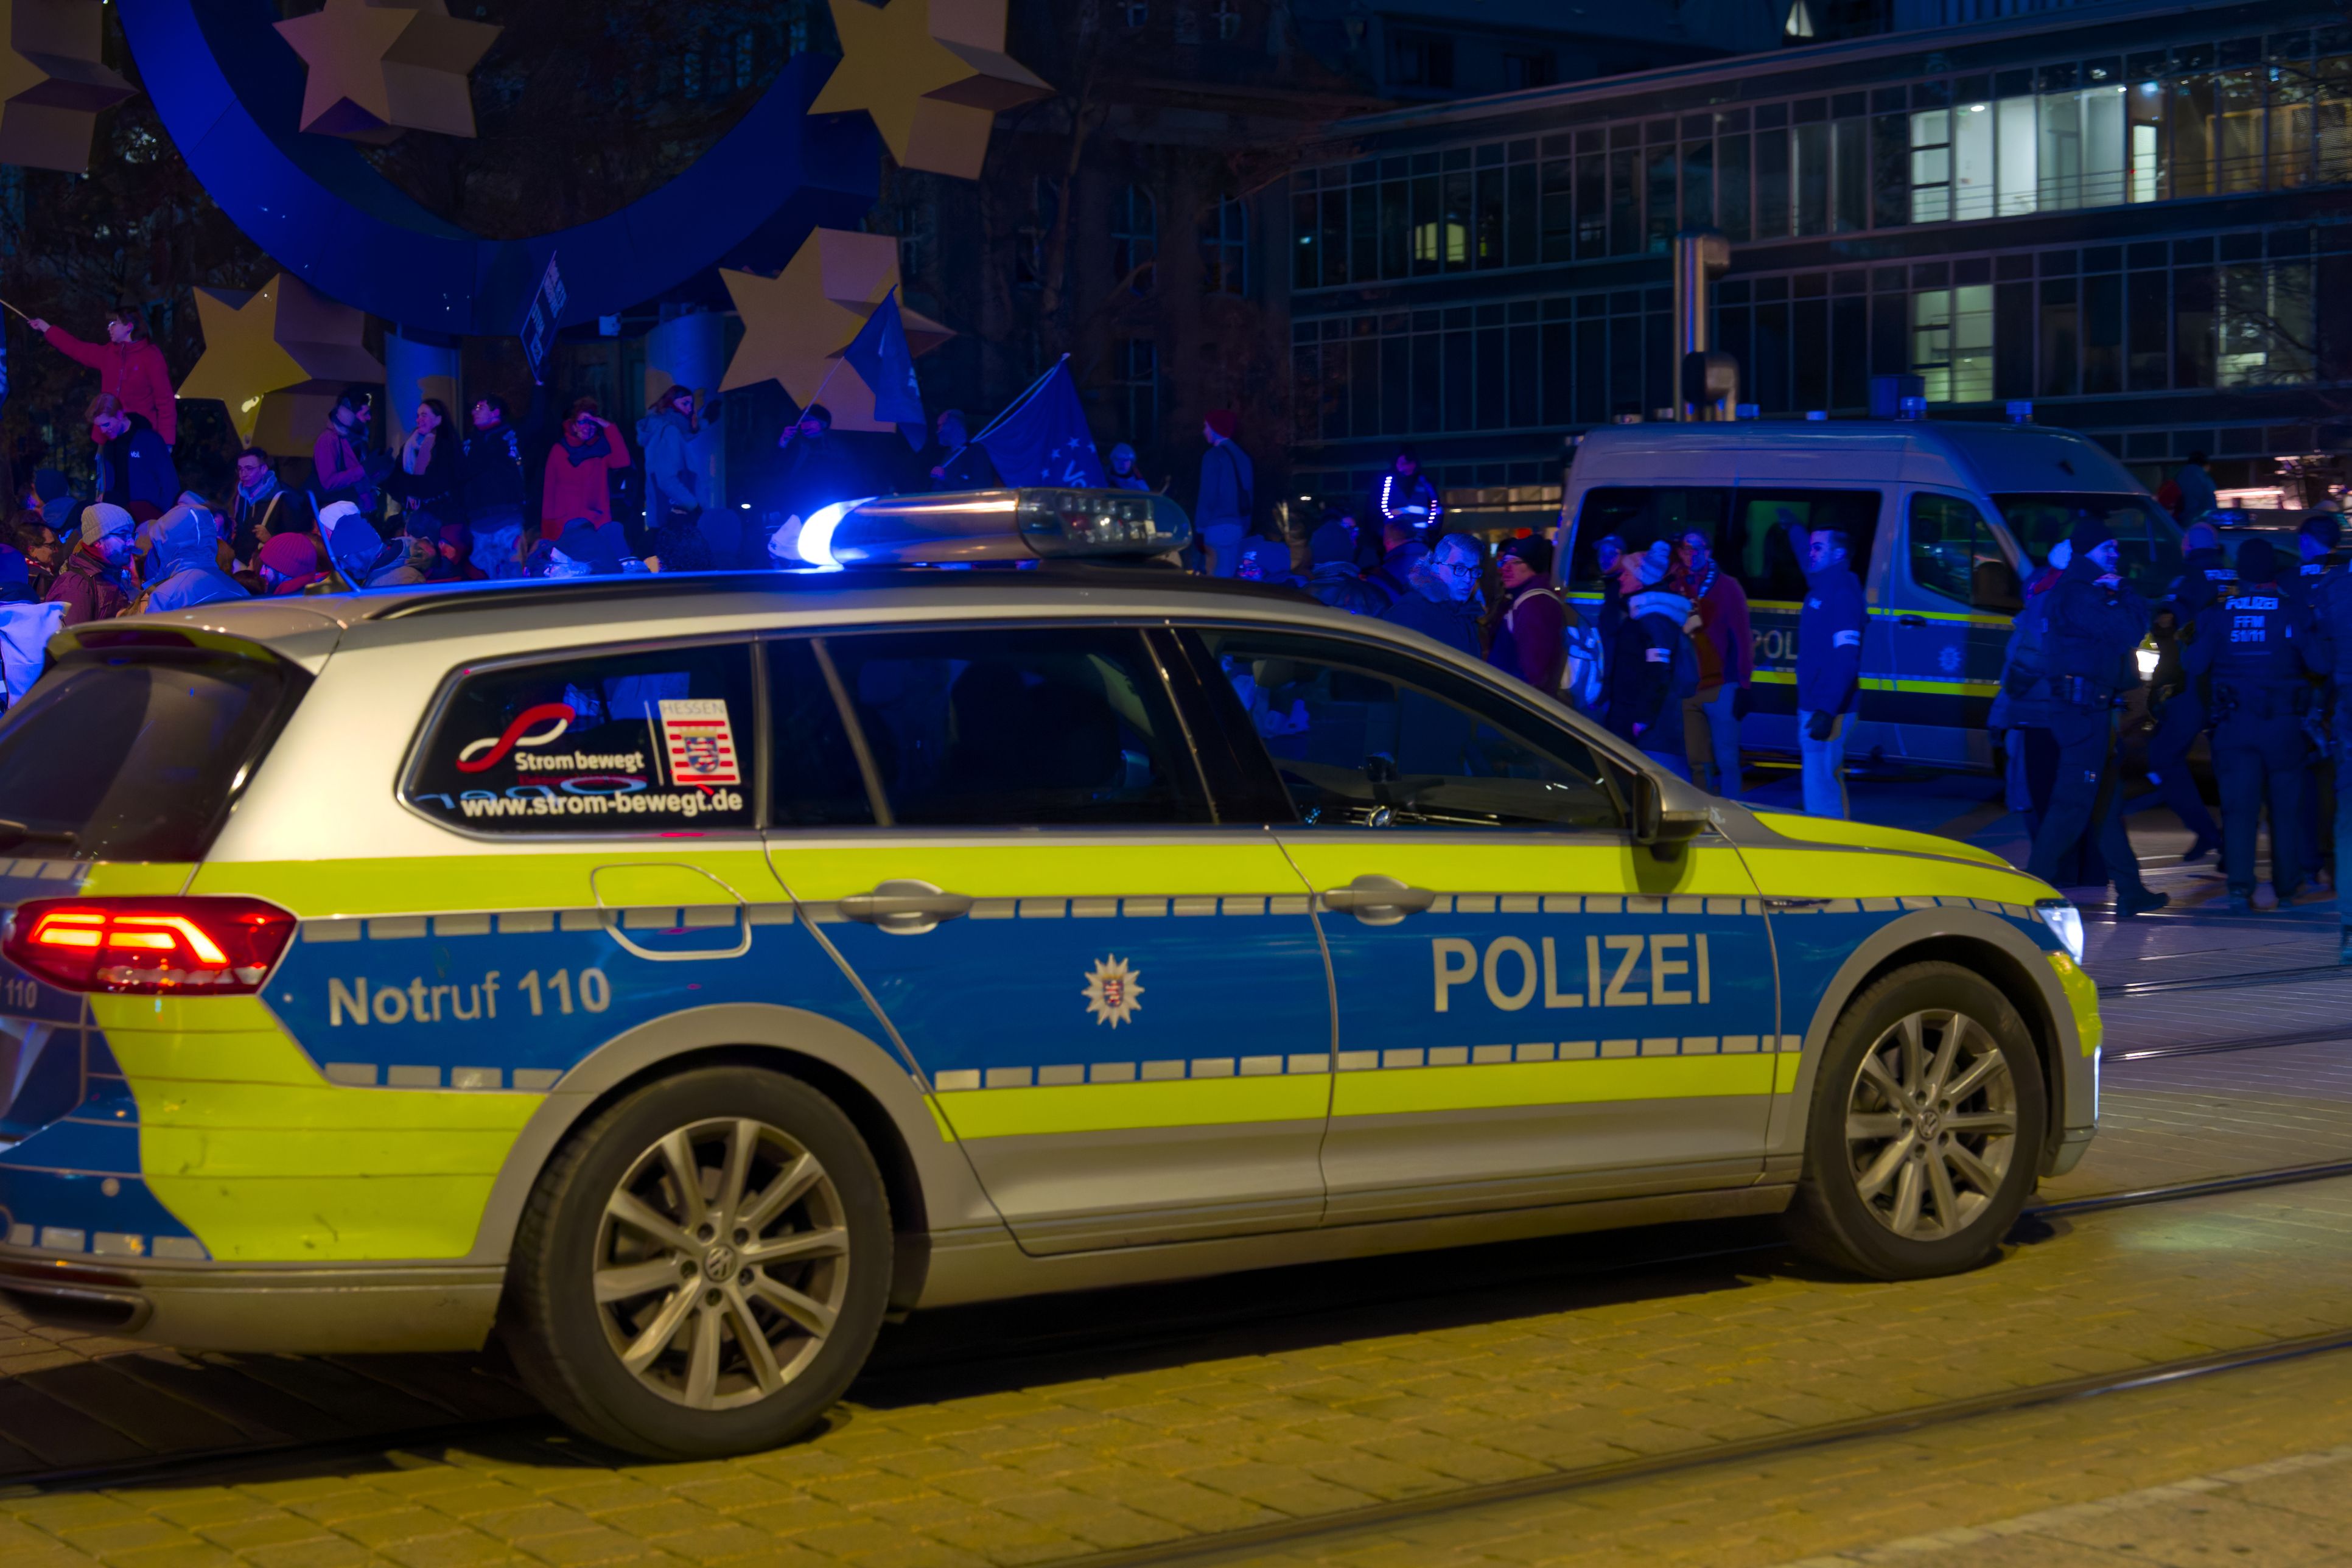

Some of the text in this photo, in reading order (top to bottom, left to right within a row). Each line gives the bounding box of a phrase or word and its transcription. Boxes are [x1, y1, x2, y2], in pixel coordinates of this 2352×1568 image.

[1749, 628, 1799, 660] POL
[662, 701, 724, 715] HESSEN
[514, 750, 645, 774] Strom bewegt
[460, 788, 743, 817] www.strom-bewegt.de
[1432, 933, 1710, 1013] POLIZEI
[328, 968, 611, 1027] Notruf 110
